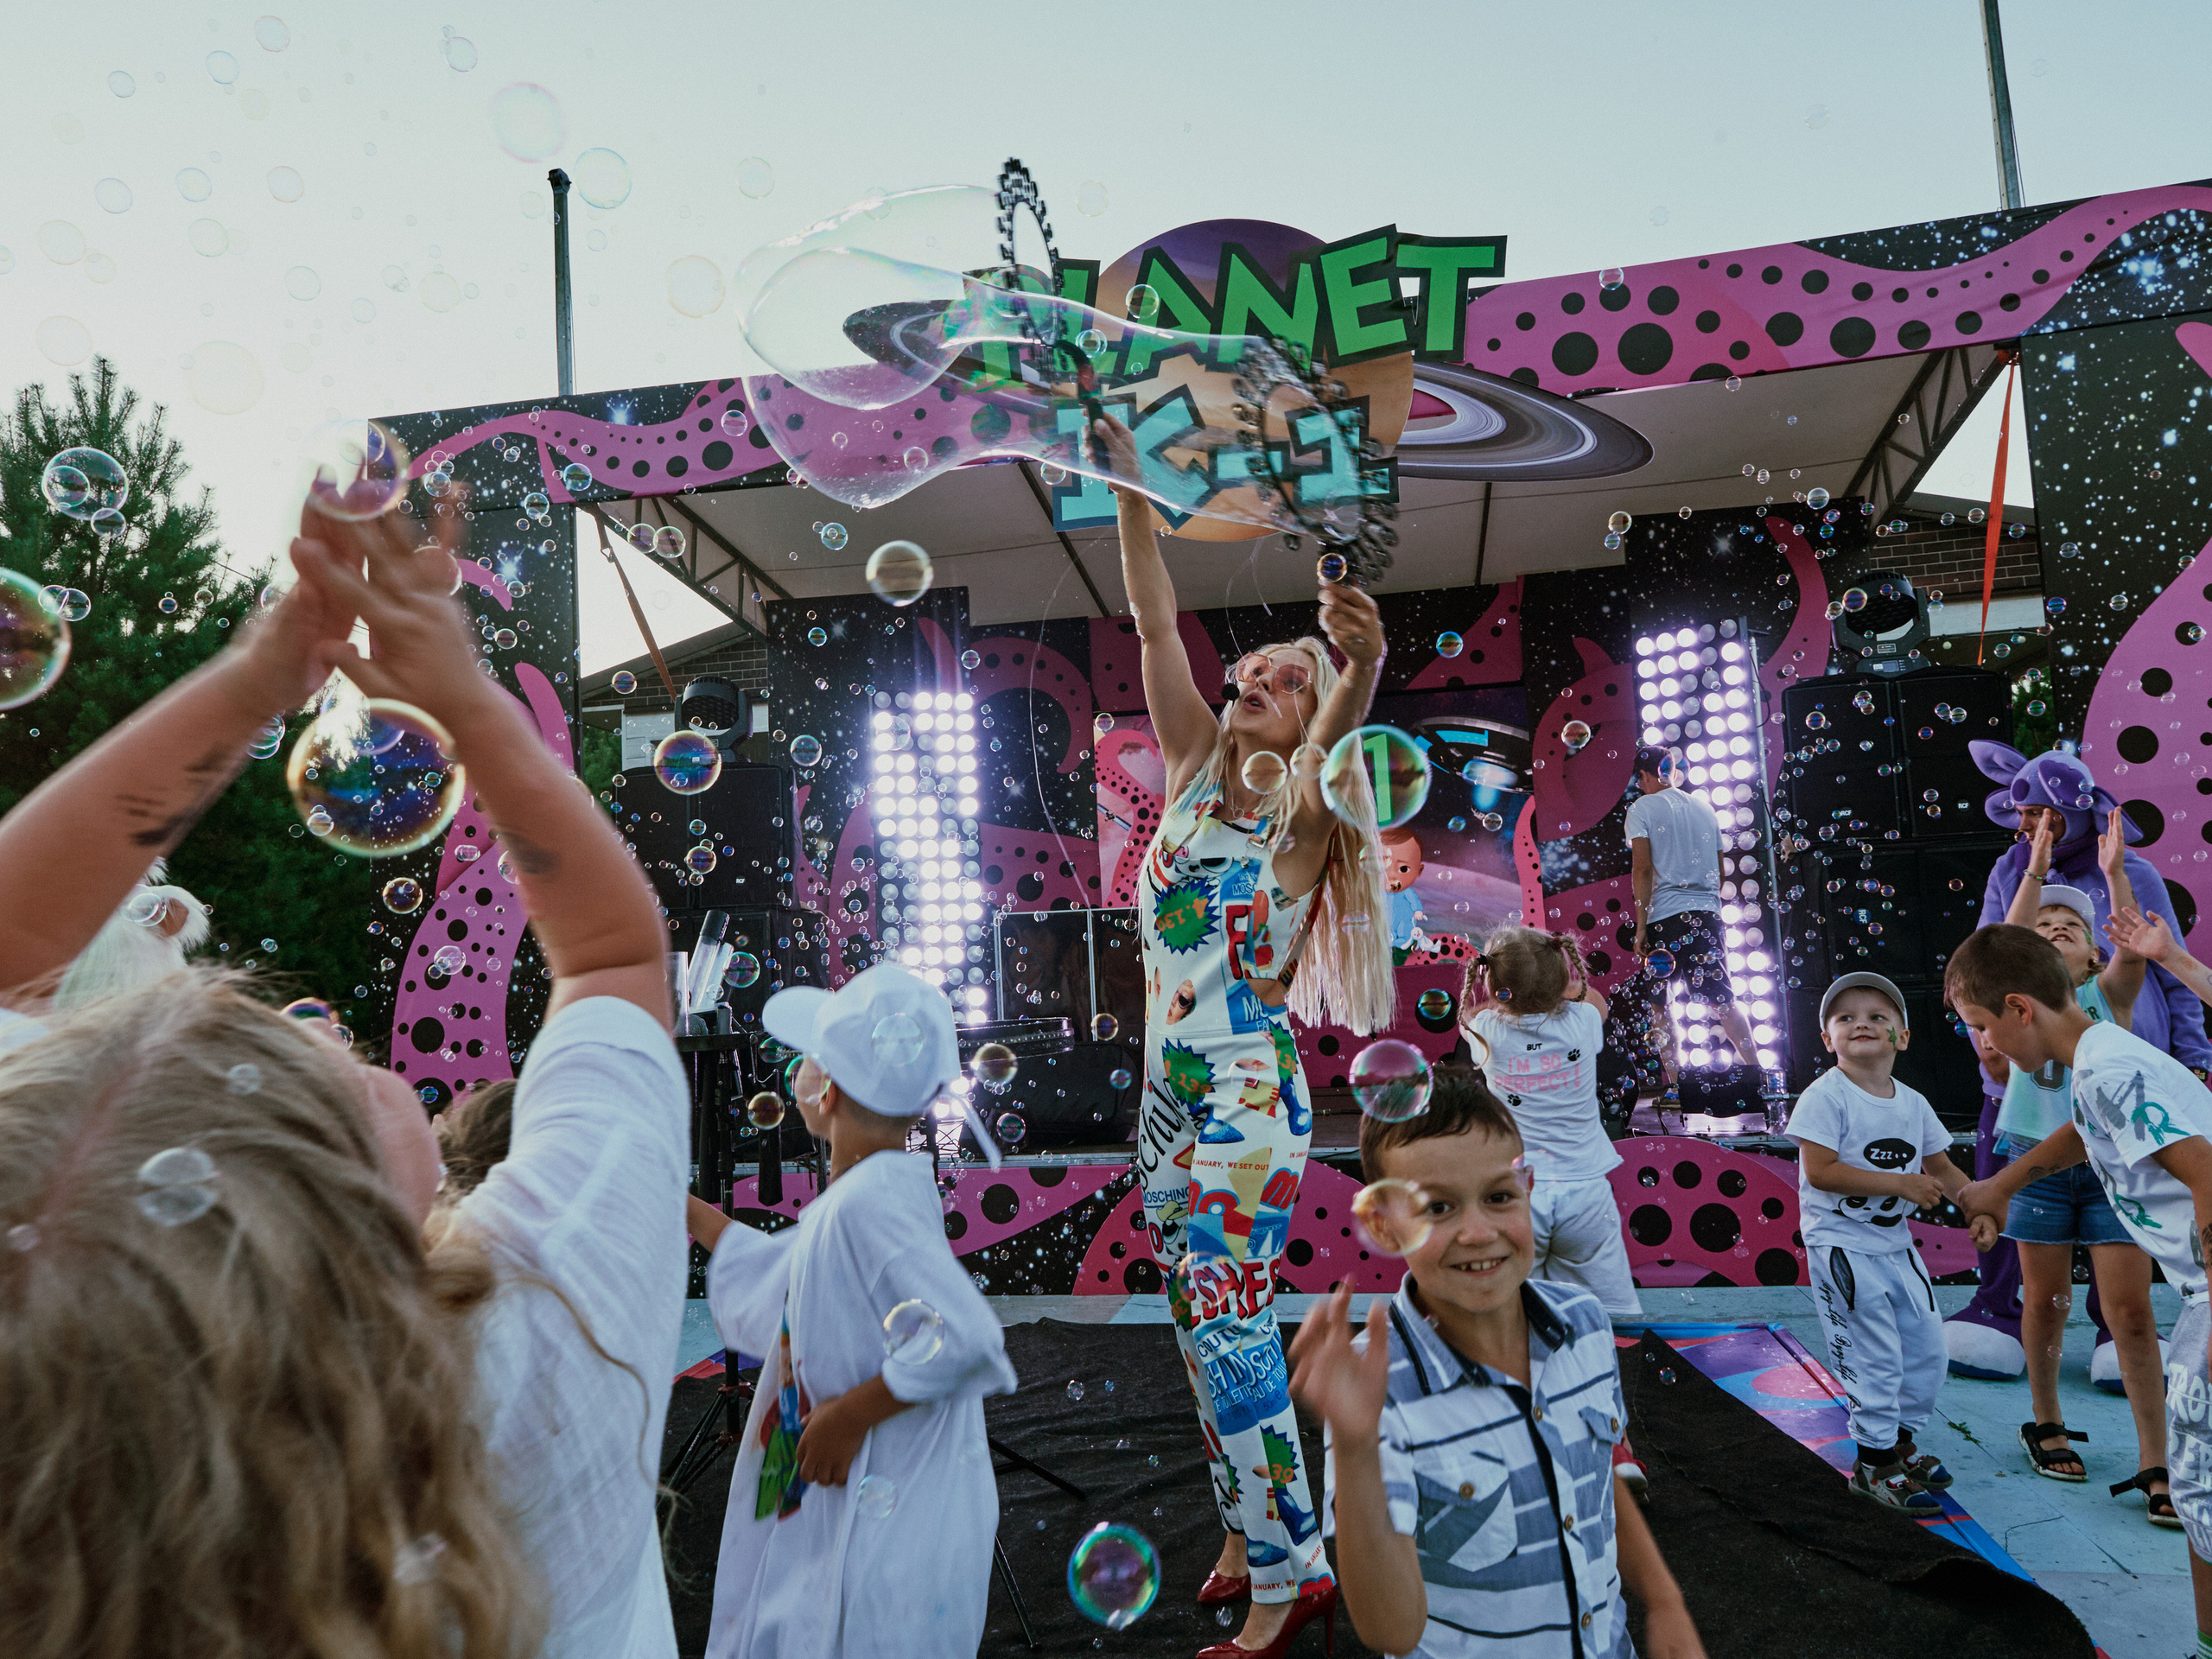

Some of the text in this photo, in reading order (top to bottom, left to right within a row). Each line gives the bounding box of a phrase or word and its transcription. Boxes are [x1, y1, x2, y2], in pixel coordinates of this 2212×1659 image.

[962, 223, 1508, 388] PLANET
[1858, 909, 1867, 924] RCF
[1508, 1053, 1561, 1073] I'M SO
